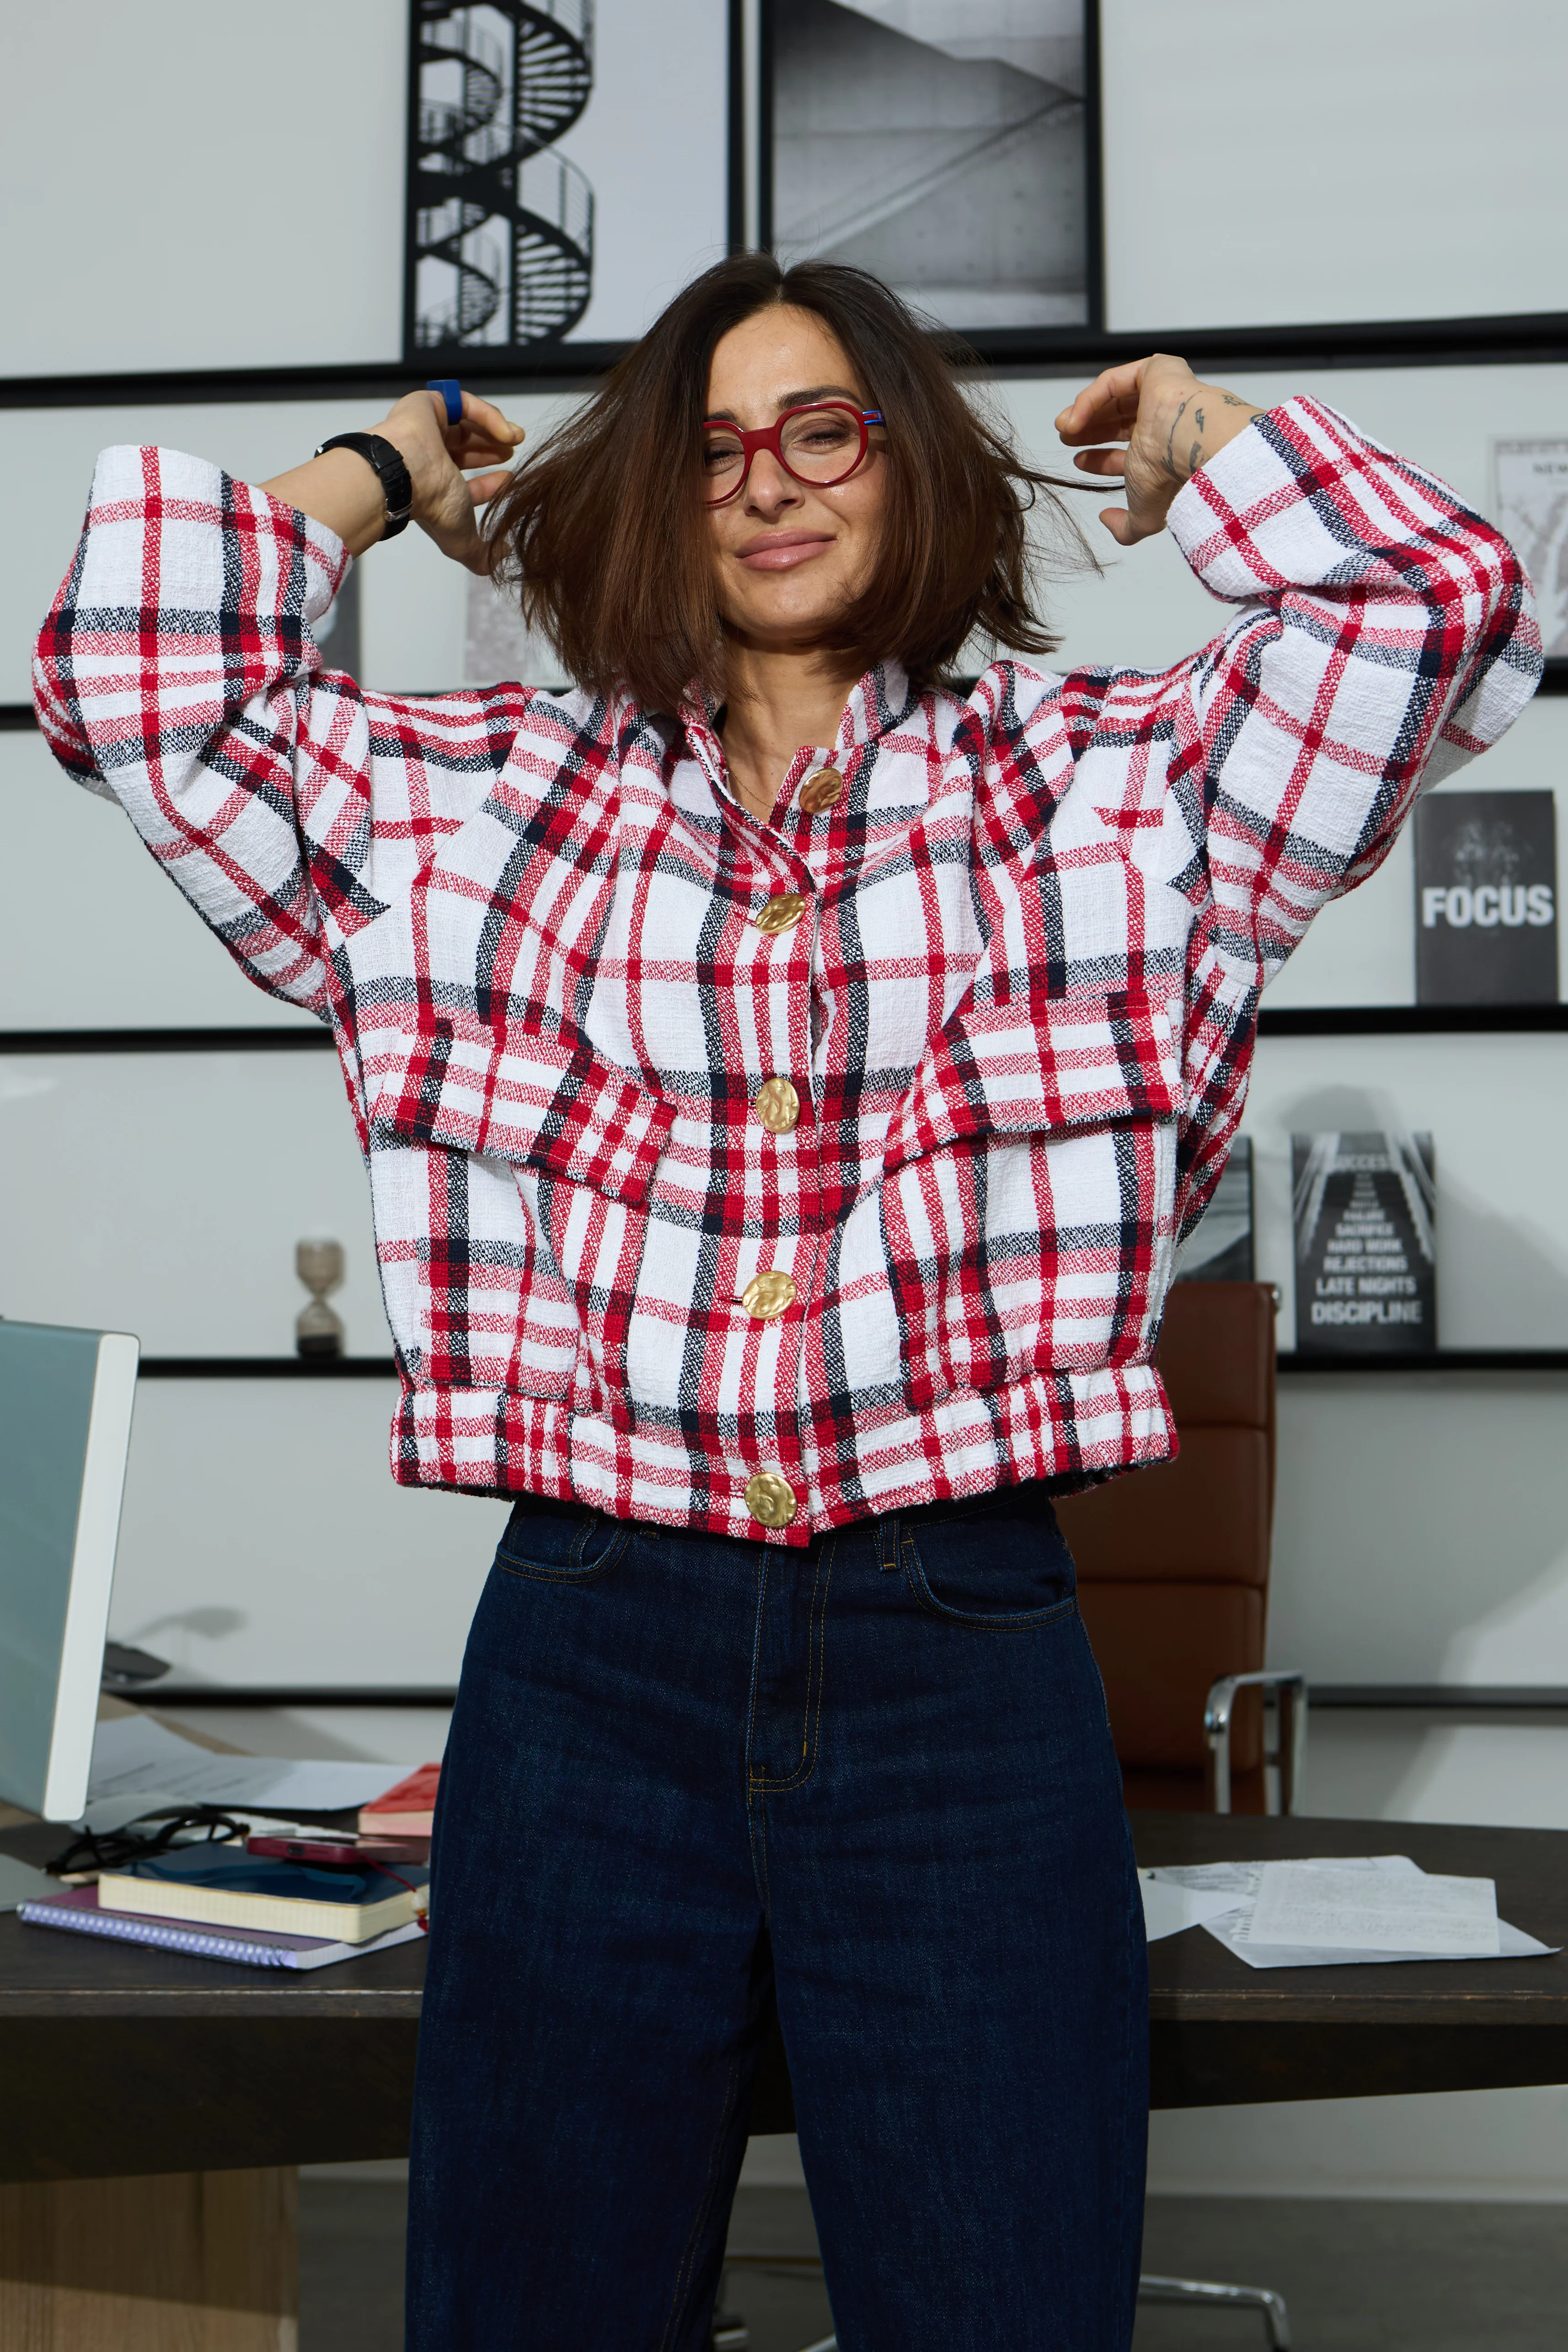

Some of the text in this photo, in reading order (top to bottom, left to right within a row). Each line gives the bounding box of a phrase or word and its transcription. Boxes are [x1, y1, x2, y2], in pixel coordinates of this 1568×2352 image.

[1422, 884, 1554, 928] FOCUS
[1335, 1153, 1395, 1171] SUCCES
[1327, 1238, 1402, 1253] HARD WORK
[1323, 1255, 1408, 1273] REJECTIONS
[1316, 1276, 1417, 1296] LATE NIGHTS
[1311, 1300, 1422, 1324] DISCIPLINE
